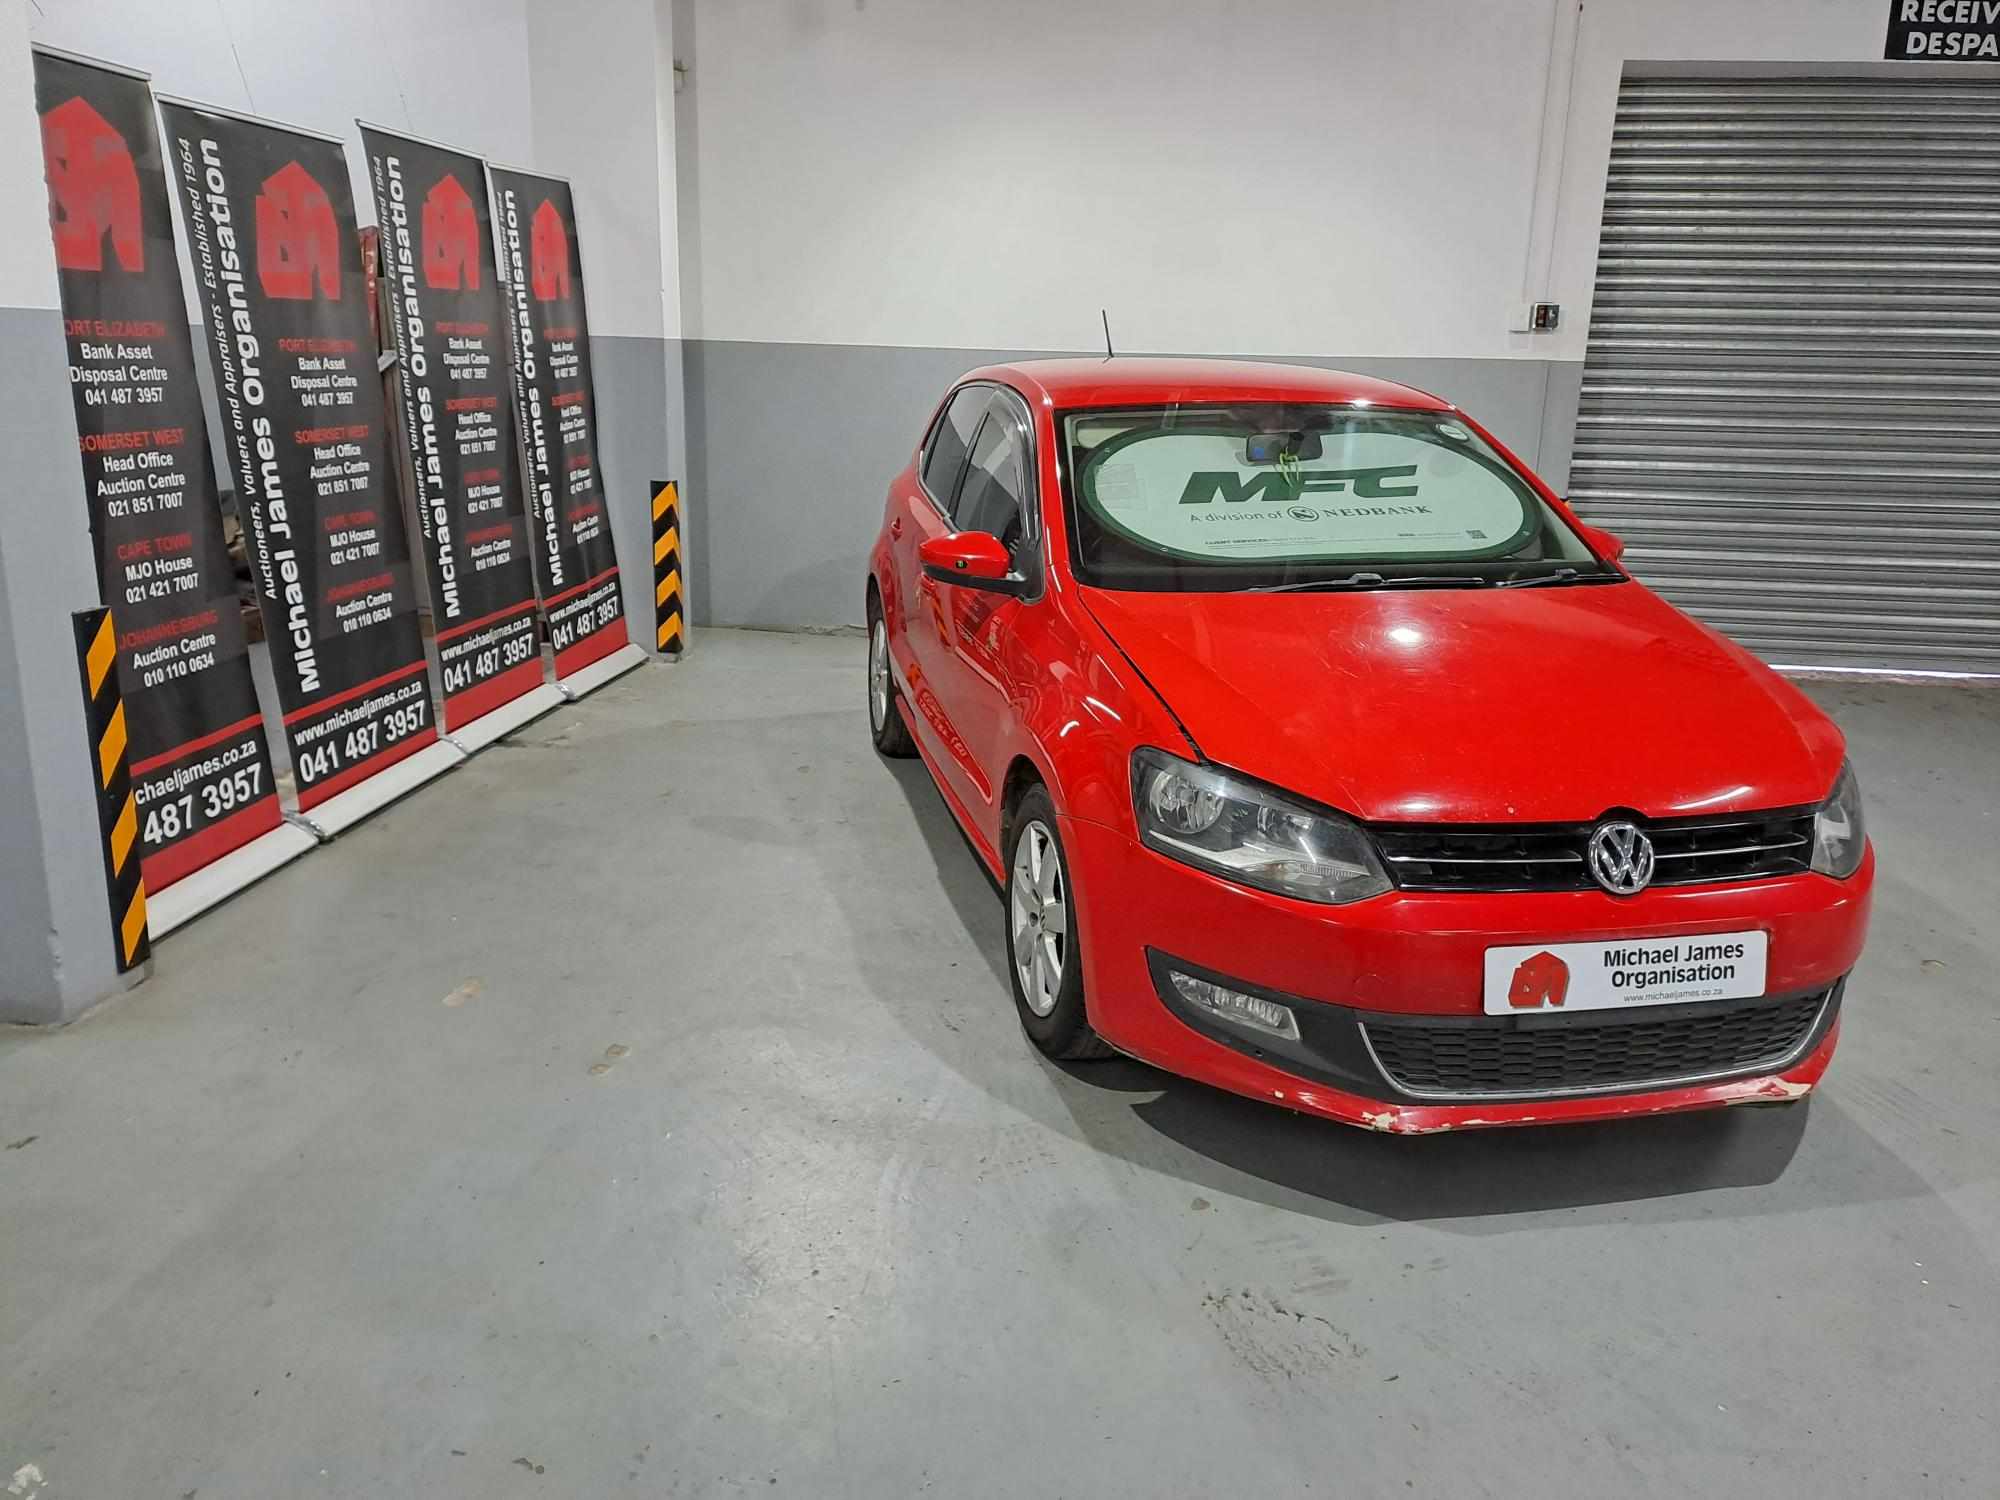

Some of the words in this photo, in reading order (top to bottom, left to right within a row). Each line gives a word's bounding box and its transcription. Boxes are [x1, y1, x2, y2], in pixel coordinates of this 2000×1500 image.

[1900, 0, 2000, 24] RECEIV
[1906, 31, 1998, 56] DESPA
[178, 137, 198, 182] 1964
[188, 187, 217, 288] Established
[200, 138, 264, 406] Organisation
[386, 156, 427, 377] Organisation
[80, 342, 114, 360] Bank
[117, 344, 152, 360] Asset
[211, 304, 236, 394] Appraisers
[298, 357, 322, 370] Bank
[70, 366, 127, 384] Disposal
[129, 365, 168, 382] Centre
[290, 375, 330, 391] Disposal
[85, 389, 107, 406] 041
[110, 388, 132, 404] 487
[136, 387, 163, 403] 3957
[226, 396, 243, 430] and
[152, 428, 185, 447] WEST
[418, 386, 443, 489] James
[528, 387, 549, 476] James
[102, 454, 135, 472] Head
[138, 452, 174, 469] Office
[236, 435, 256, 496] Valuers
[252, 417, 292, 540] James
[310, 464, 343, 480] Auction
[97, 476, 145, 496] Auction
[148, 472, 186, 489] Centre
[1178, 465, 1419, 504] MFC
[108, 501, 130, 518] 021
[132, 497, 154, 514] 851
[156, 492, 183, 511] 7007
[1190, 513, 1201, 523] A
[1206, 511, 1264, 522] division
[1267, 510, 1283, 520] of
[1322, 505, 1433, 518] NEDBANK
[251, 501, 276, 599] Auctioneers,
[538, 482, 564, 586] Michael
[125, 562, 152, 582] MJO
[154, 557, 193, 574] House
[430, 498, 461, 618] Michael
[126, 587, 146, 604] 021
[149, 581, 170, 598] 421
[174, 573, 199, 592] 7007
[274, 550, 320, 692] Michael
[336, 600, 366, 618] Auction
[552, 621, 574, 650] 041
[576, 610, 595, 636] 487
[596, 596, 618, 625] 3957
[133, 645, 178, 670] Auction
[180, 632, 216, 654] Centre
[444, 656, 472, 692] 041
[476, 648, 499, 676] 487
[502, 633, 534, 666] 3957
[144, 670, 164, 688] 010
[166, 662, 187, 678] 110
[189, 652, 215, 672] 0634
[294, 680, 422, 746] www.michaeljames.co.za
[300, 741, 339, 784] 041
[344, 722, 379, 760] 487
[384, 700, 426, 742] 3957
[144, 794, 193, 845] 487
[202, 762, 262, 818] 3957
[1604, 946, 1679, 967] Michael
[1684, 944, 1744, 962] James
[1612, 964, 1735, 989] Organisation
